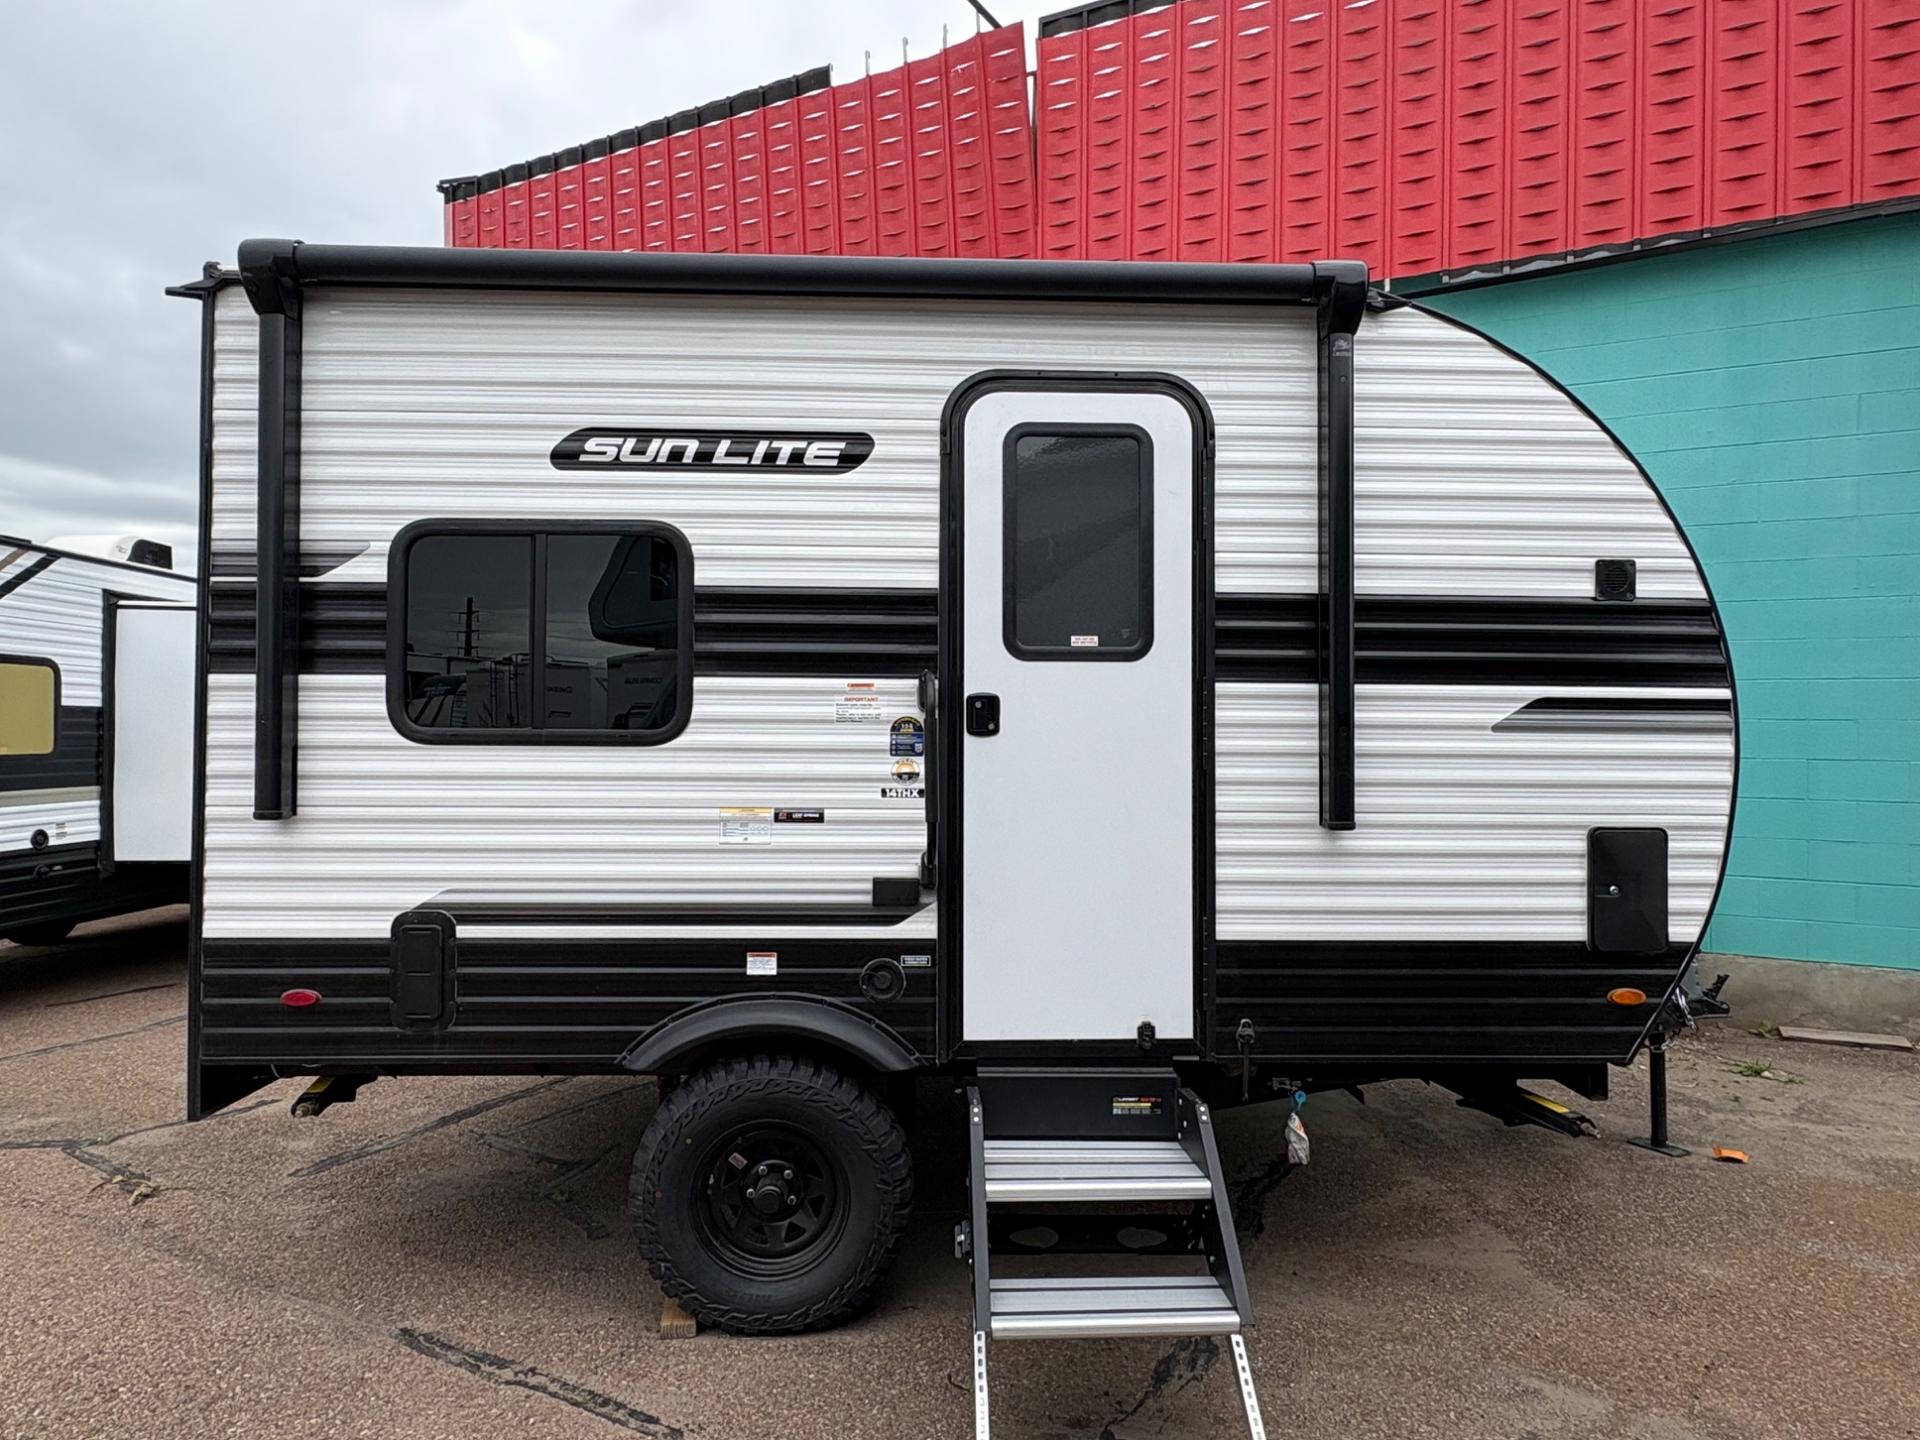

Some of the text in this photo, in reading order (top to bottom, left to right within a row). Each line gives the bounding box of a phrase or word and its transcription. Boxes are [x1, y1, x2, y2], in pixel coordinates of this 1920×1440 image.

[578, 437, 846, 466] SUN LITE
[885, 788, 920, 798] 14THX
